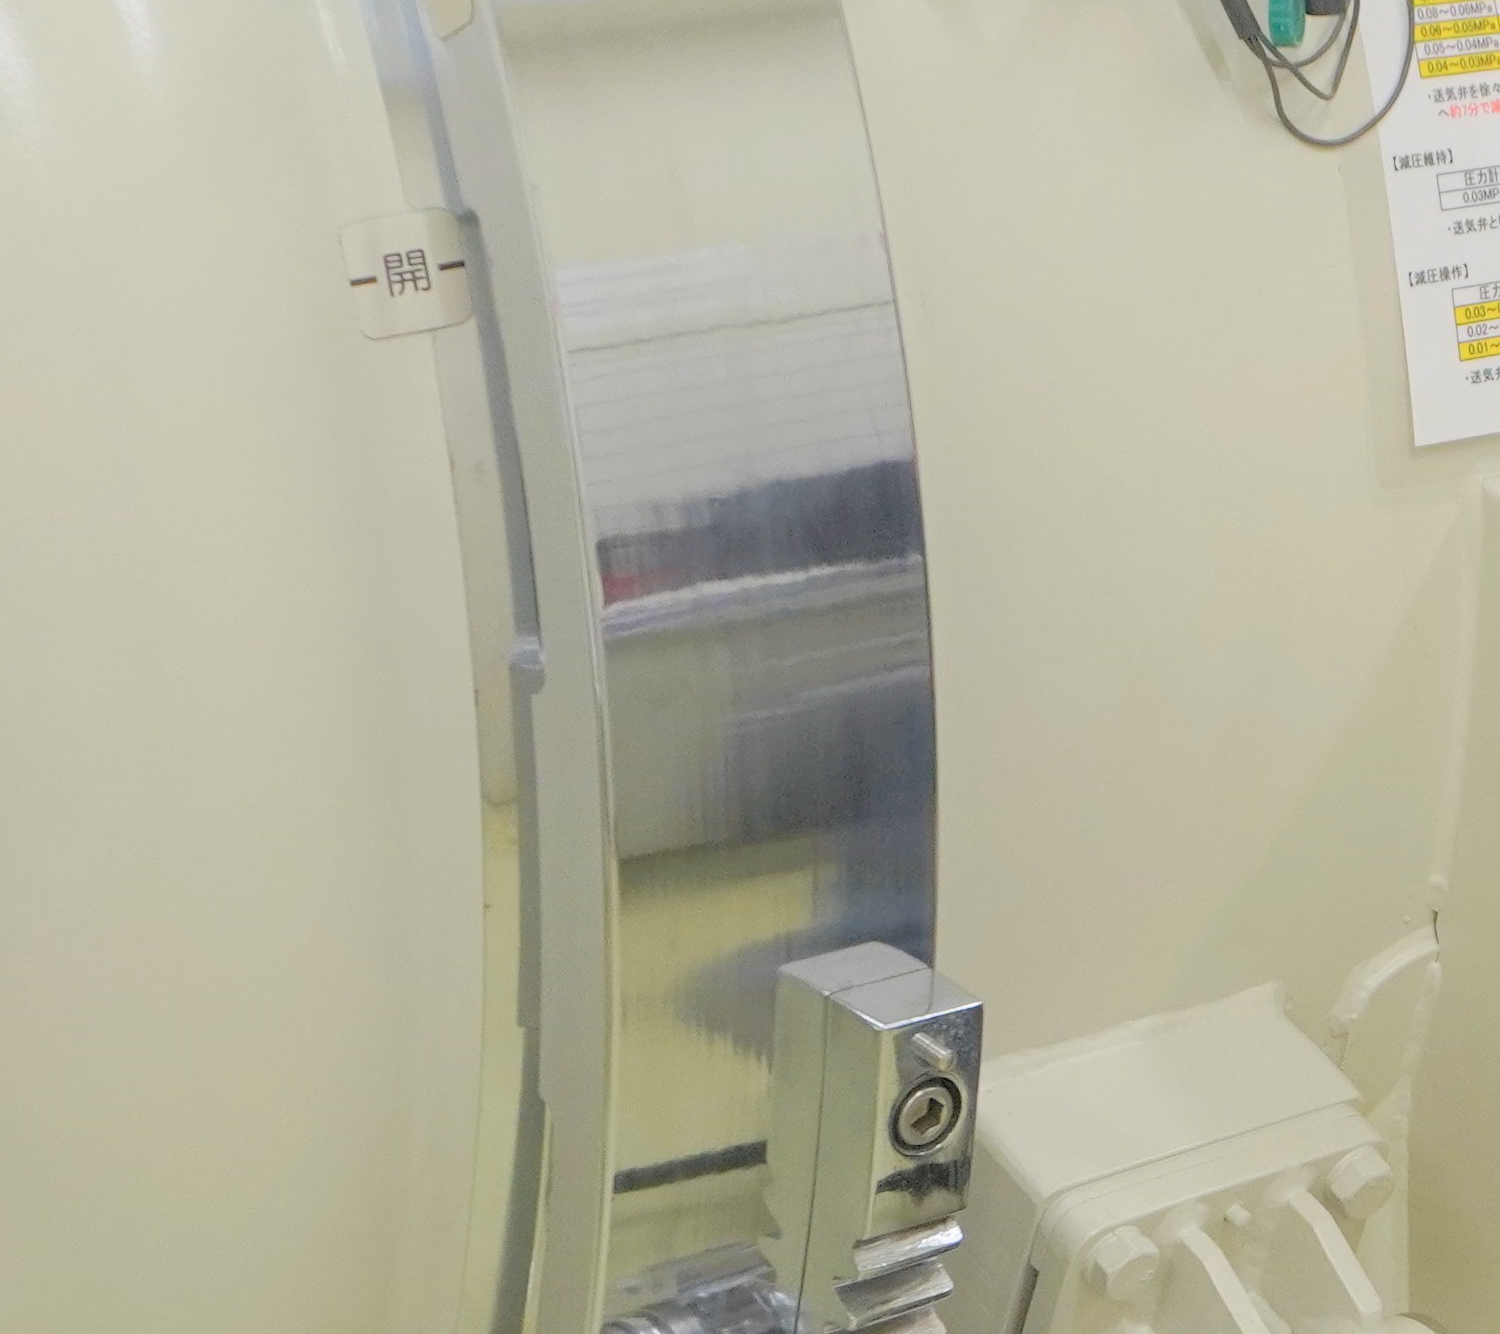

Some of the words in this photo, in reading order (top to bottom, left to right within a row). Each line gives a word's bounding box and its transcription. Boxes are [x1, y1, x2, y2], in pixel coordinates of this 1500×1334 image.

[1464, 170, 1499, 186] 圧力計
[383, 248, 432, 298] 開
